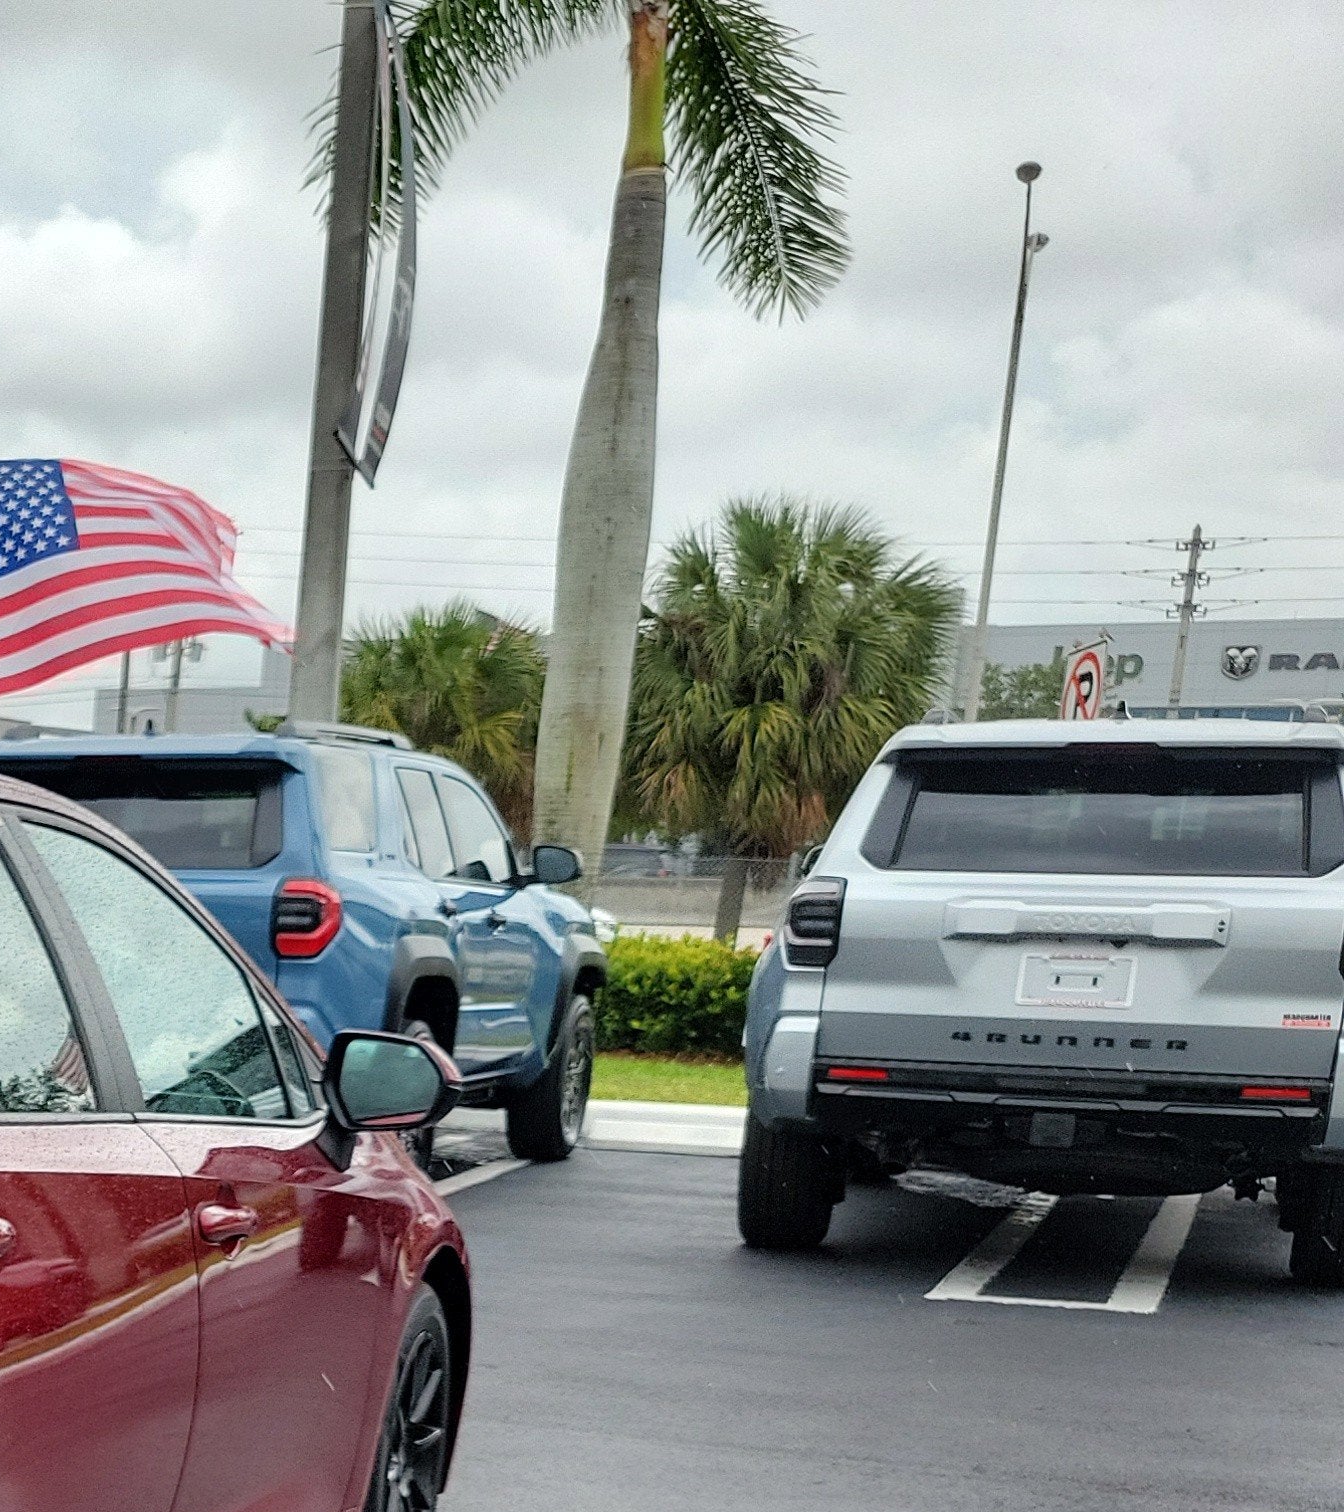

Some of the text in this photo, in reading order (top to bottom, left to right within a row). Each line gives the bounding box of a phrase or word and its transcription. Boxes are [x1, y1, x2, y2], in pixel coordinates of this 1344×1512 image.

[1268, 653, 1344, 670] RA
[1033, 914, 1136, 932] TOYOTA
[951, 1031, 1188, 1050] 4RUNNER
